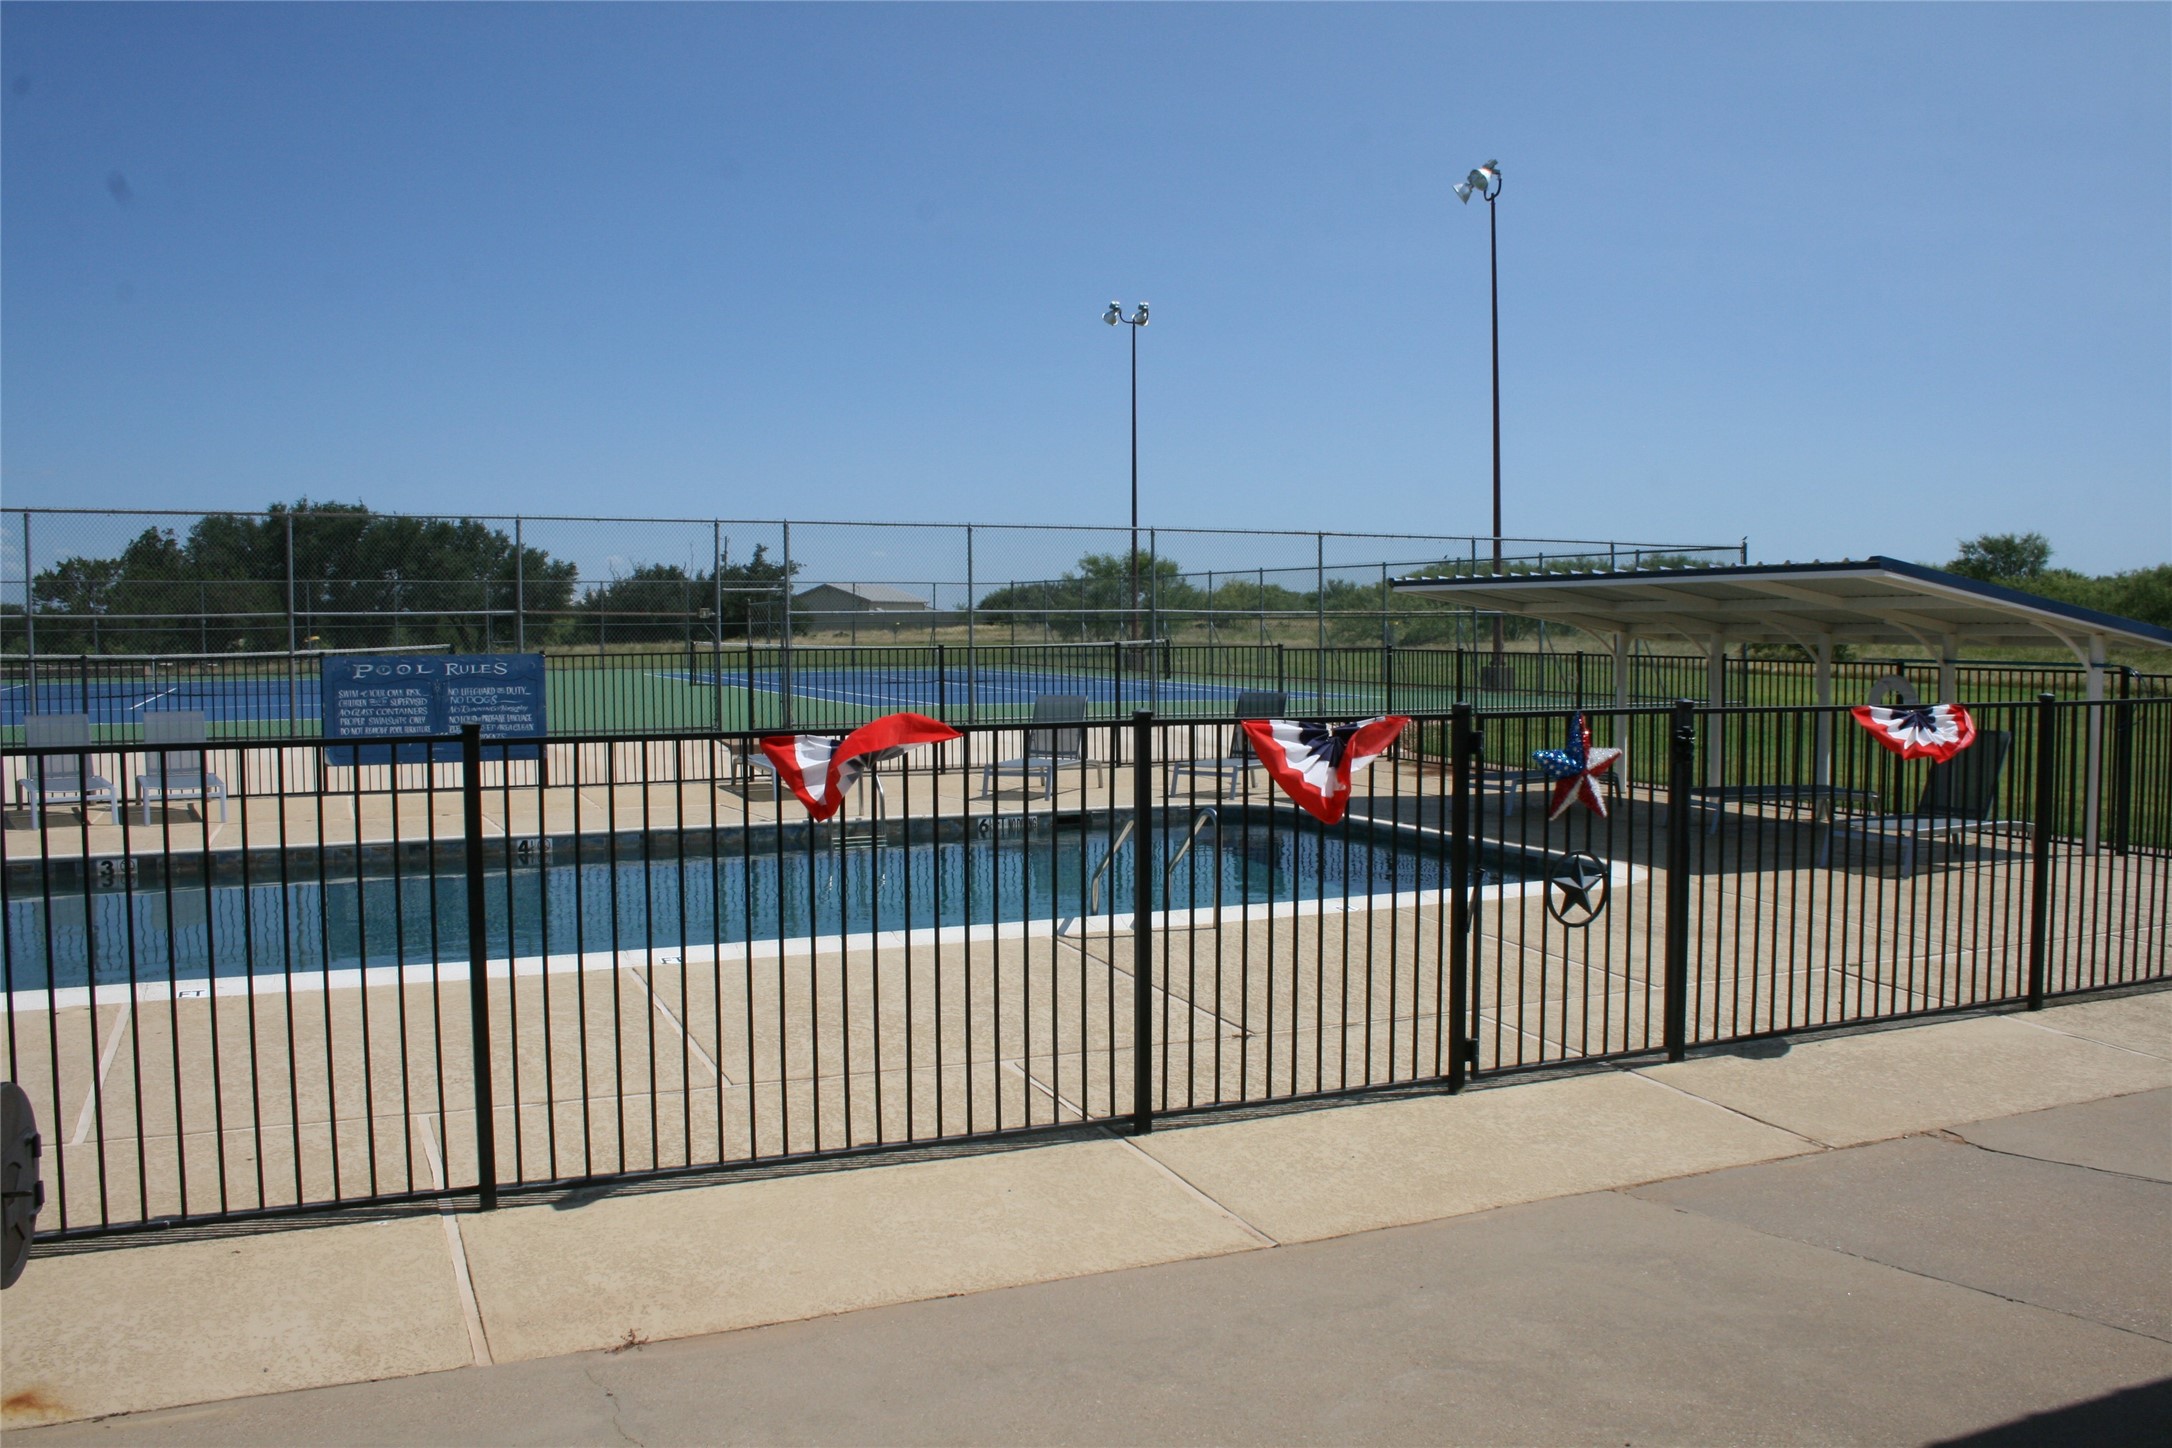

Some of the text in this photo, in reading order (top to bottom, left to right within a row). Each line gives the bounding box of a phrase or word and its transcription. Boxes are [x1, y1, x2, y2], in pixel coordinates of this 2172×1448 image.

[353, 662, 508, 679] POOL RULES
[338, 690, 359, 699] SWIM
[448, 687, 459, 696] NO
[461, 687, 496, 696] LIFEGUARD
[506, 686, 527, 695] DUTY
[390, 698, 428, 707] SUPERVISED
[450, 695, 498, 705] NO DOGS
[351, 708, 375, 717] GLASS
[376, 707, 428, 716] CONTAINERS
[340, 717, 366, 726] PROPER
[448, 715, 460, 724] NO
[340, 727, 350, 736] DO
[350, 726, 364, 735] NOT
[389, 726, 403, 734] POOL
[178, 989, 206, 998] FT
